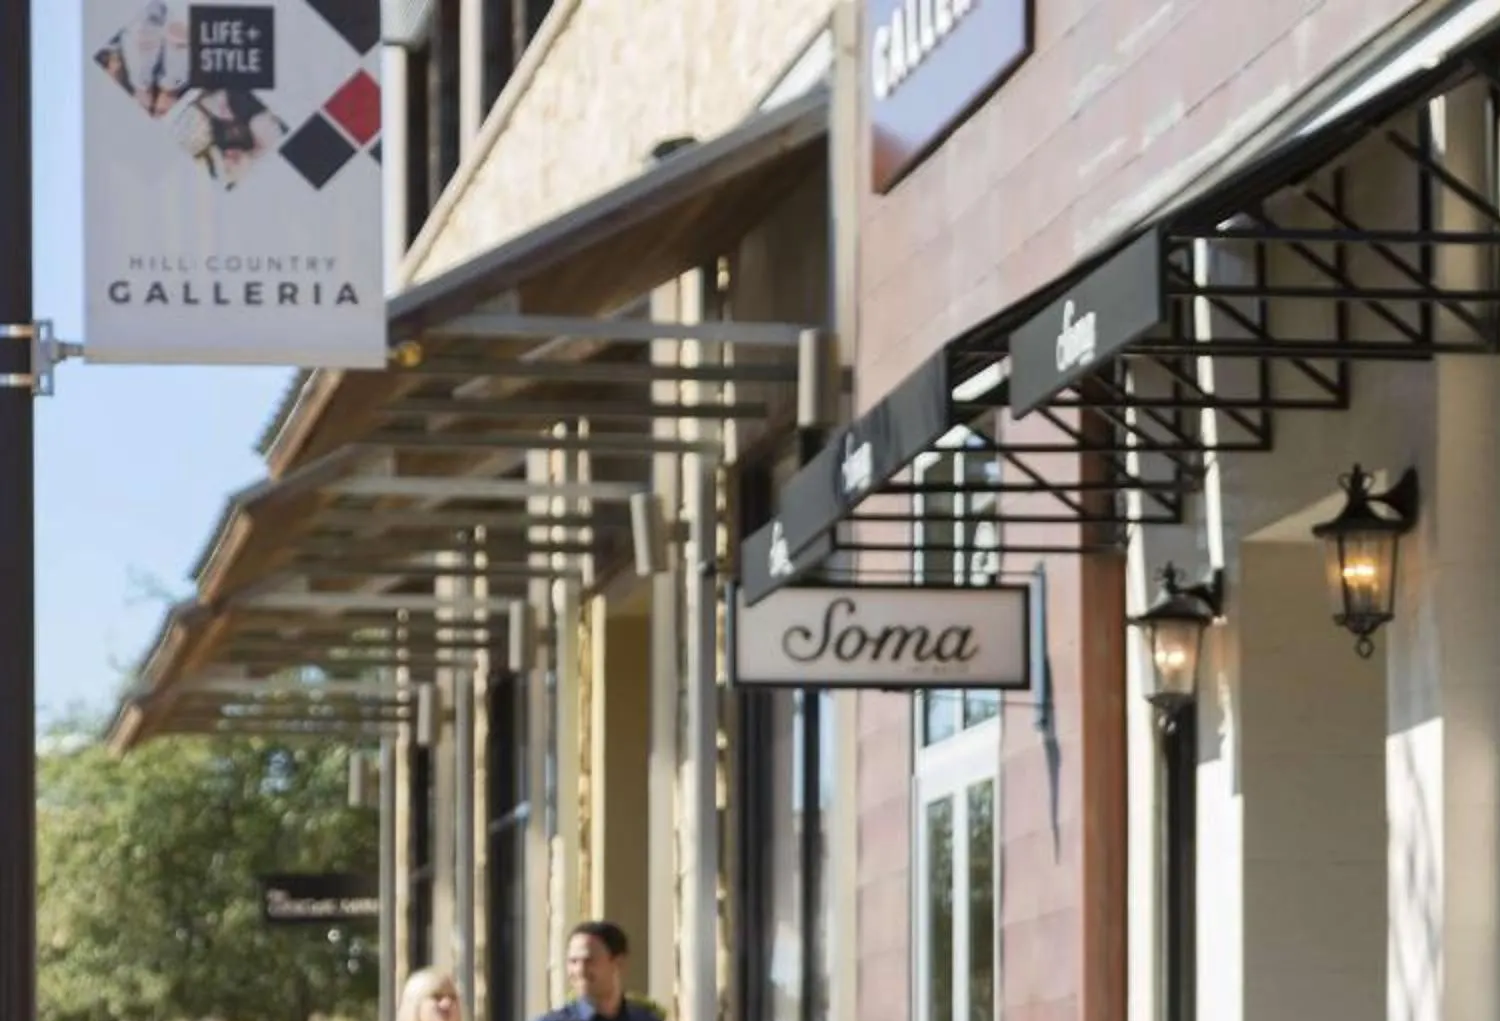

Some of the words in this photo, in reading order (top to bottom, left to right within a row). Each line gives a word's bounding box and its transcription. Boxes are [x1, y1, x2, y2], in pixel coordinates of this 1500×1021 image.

[200, 47, 262, 73] STYLE
[129, 255, 191, 272] HILL
[205, 255, 337, 272] COUNTRY
[107, 279, 360, 306] GALLERIA
[782, 597, 981, 663] Soma
